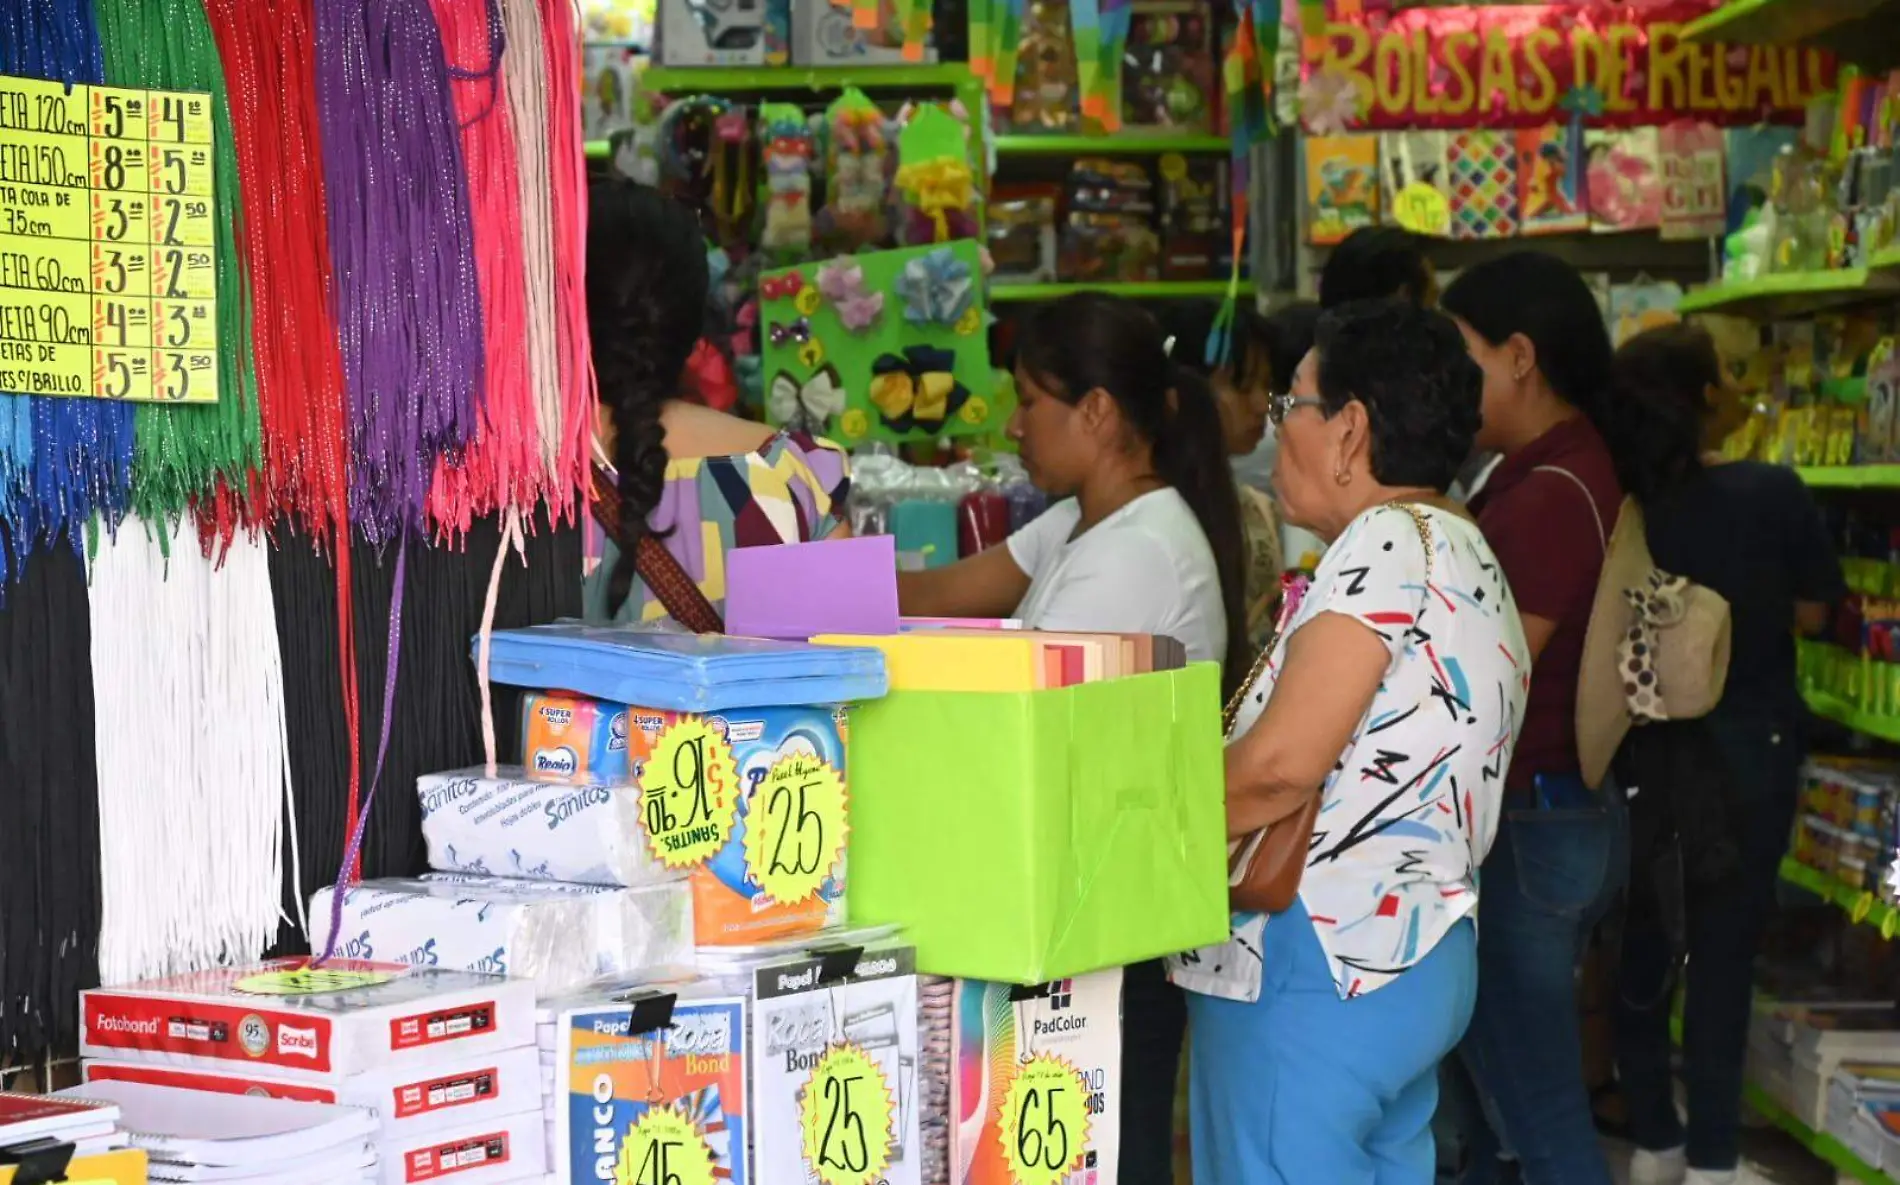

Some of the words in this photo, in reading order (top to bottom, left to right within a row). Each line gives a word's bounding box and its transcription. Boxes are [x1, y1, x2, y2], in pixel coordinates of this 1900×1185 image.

[1324, 23, 1562, 114] BOLSAS
[1572, 24, 1640, 112] DE
[21, 188, 49, 206] COLA
[56, 192, 70, 206] DE
[38, 345, 56, 361] DE
[0, 370, 17, 389] ES
[545, 707, 572, 719] SUPER
[638, 715, 664, 726] SUPER
[544, 784, 611, 831] Sanitas
[97, 1013, 158, 1035] Fotobond
[280, 1032, 315, 1050] Scribe
[665, 1022, 726, 1050] Roca
[1034, 1015, 1087, 1035] PadColor
[686, 1051, 730, 1075] Bond
[593, 1073, 616, 1185] ANCO
